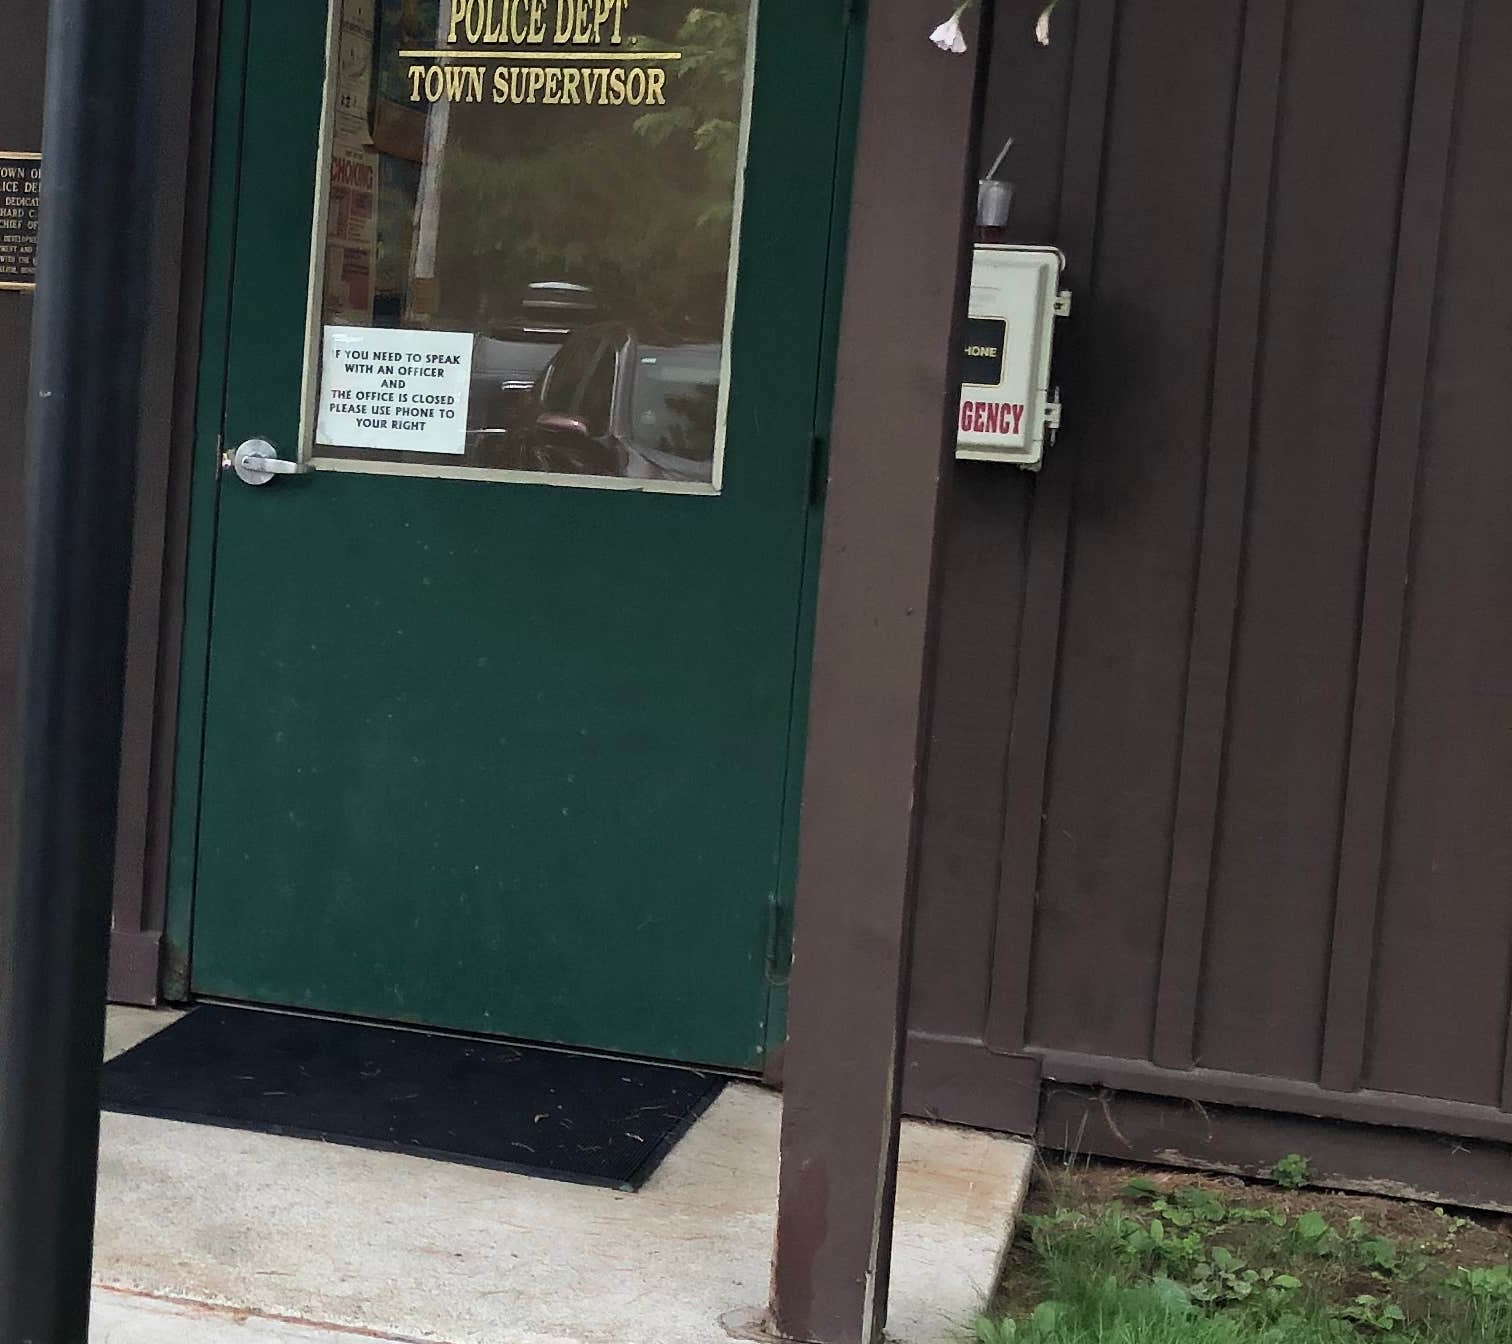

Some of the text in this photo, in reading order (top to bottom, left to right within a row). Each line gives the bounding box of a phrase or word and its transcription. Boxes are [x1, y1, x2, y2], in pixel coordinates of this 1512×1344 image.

[408, 65, 666, 105] TOWN SUPERVISOR
[345, 350, 369, 361] YOU
[373, 351, 402, 362] NEED
[406, 353, 422, 363] TO
[425, 354, 461, 365] SPEAK
[344, 363, 445, 378] WITH AN OFFICER
[380, 379, 406, 389] AND
[331, 389, 455, 405] THE OFFICE IS CLOSED
[329, 403, 455, 419] PLEASE USE PHONE TO
[356, 418, 426, 431] YOUR RIGHT
